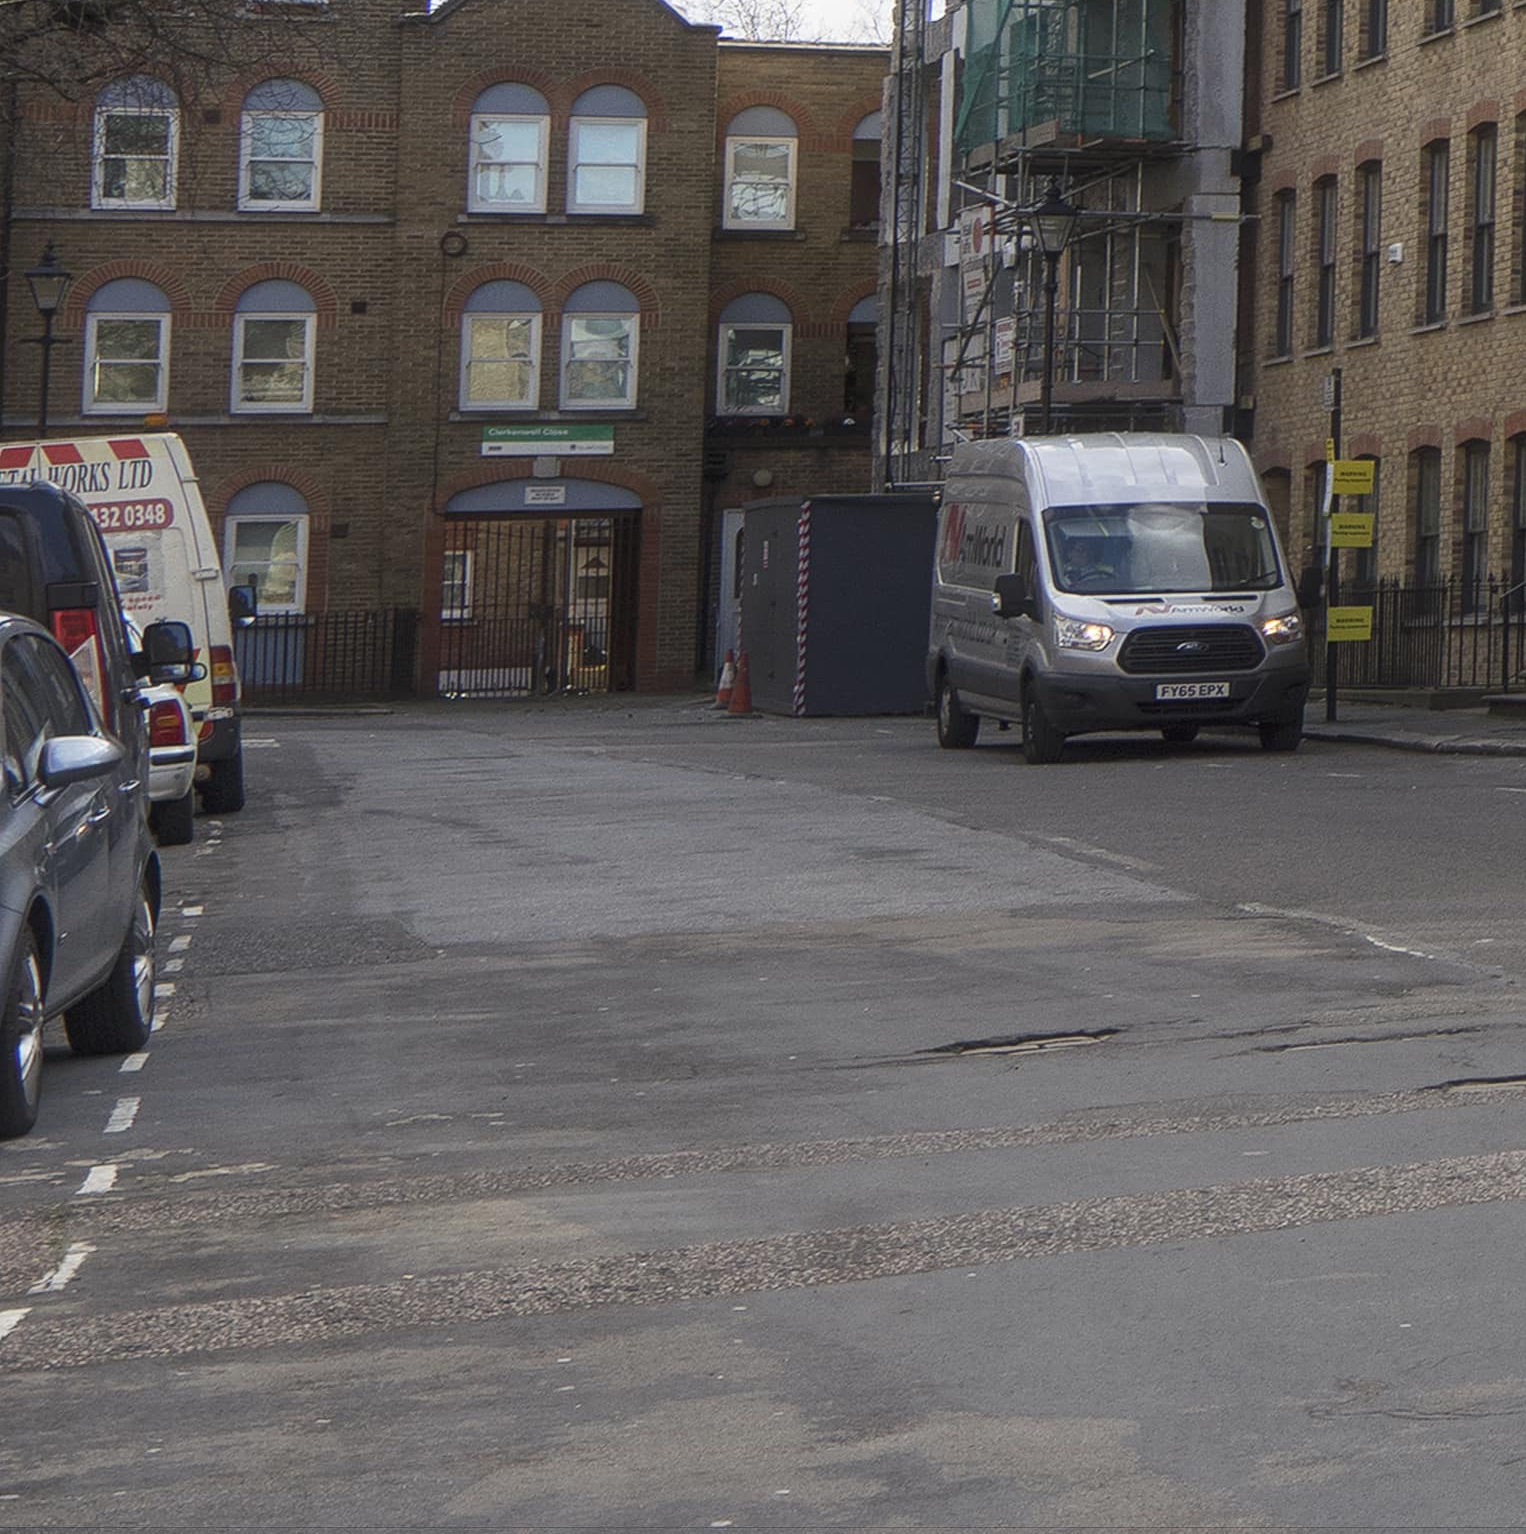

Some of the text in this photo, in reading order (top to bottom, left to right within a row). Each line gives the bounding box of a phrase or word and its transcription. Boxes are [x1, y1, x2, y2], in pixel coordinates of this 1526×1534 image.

[118, 459, 153, 490] LTD
[124, 503, 166, 527] 0348
[1161, 684, 1225, 698] FY65 EPX
